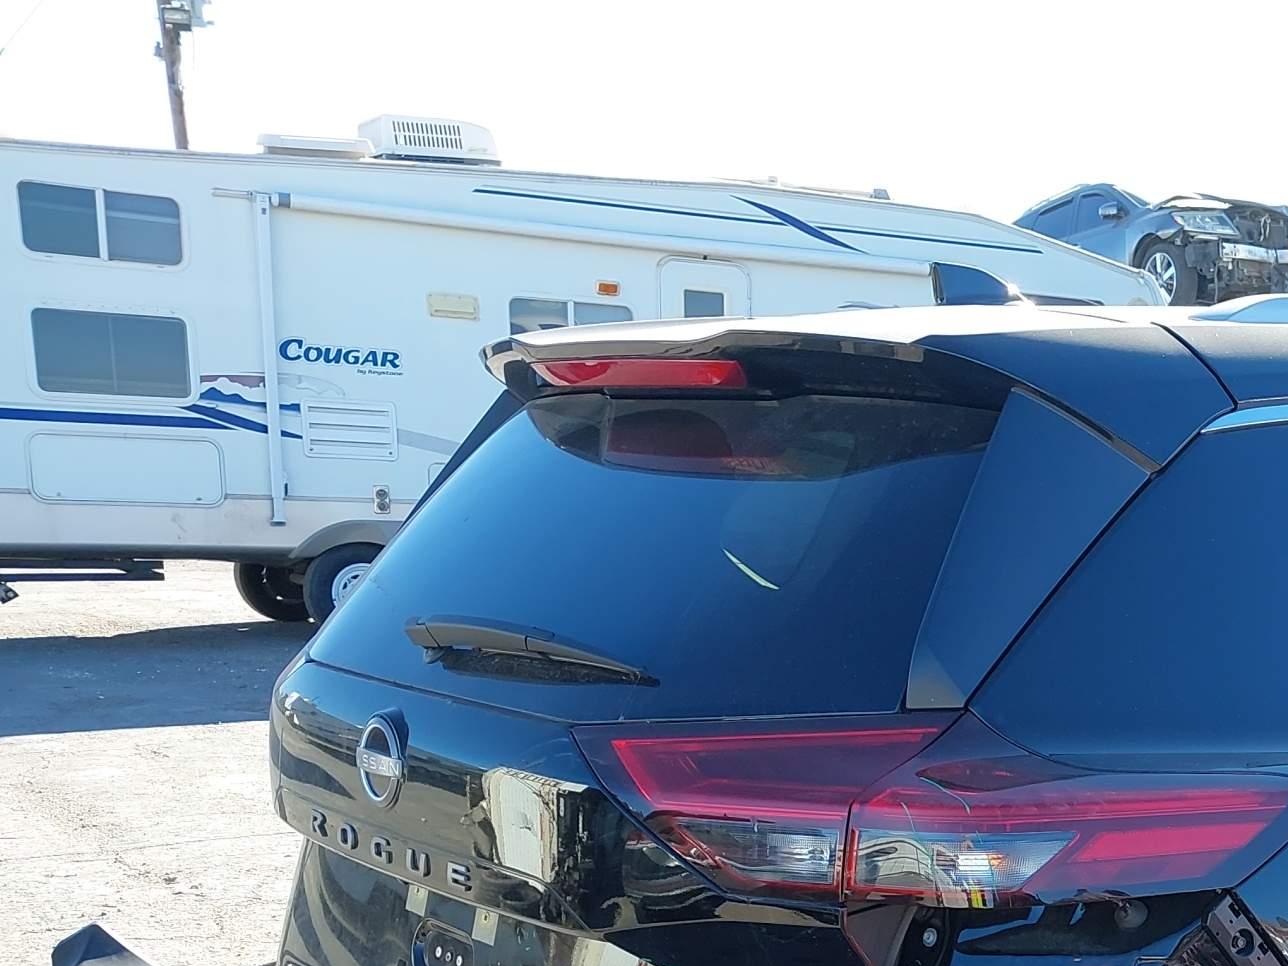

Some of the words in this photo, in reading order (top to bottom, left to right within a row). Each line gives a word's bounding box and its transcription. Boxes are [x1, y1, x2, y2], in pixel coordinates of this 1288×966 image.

[278, 338, 401, 369] COUGAR
[359, 752, 400, 778] SSAN
[311, 809, 473, 892] ROGUE
